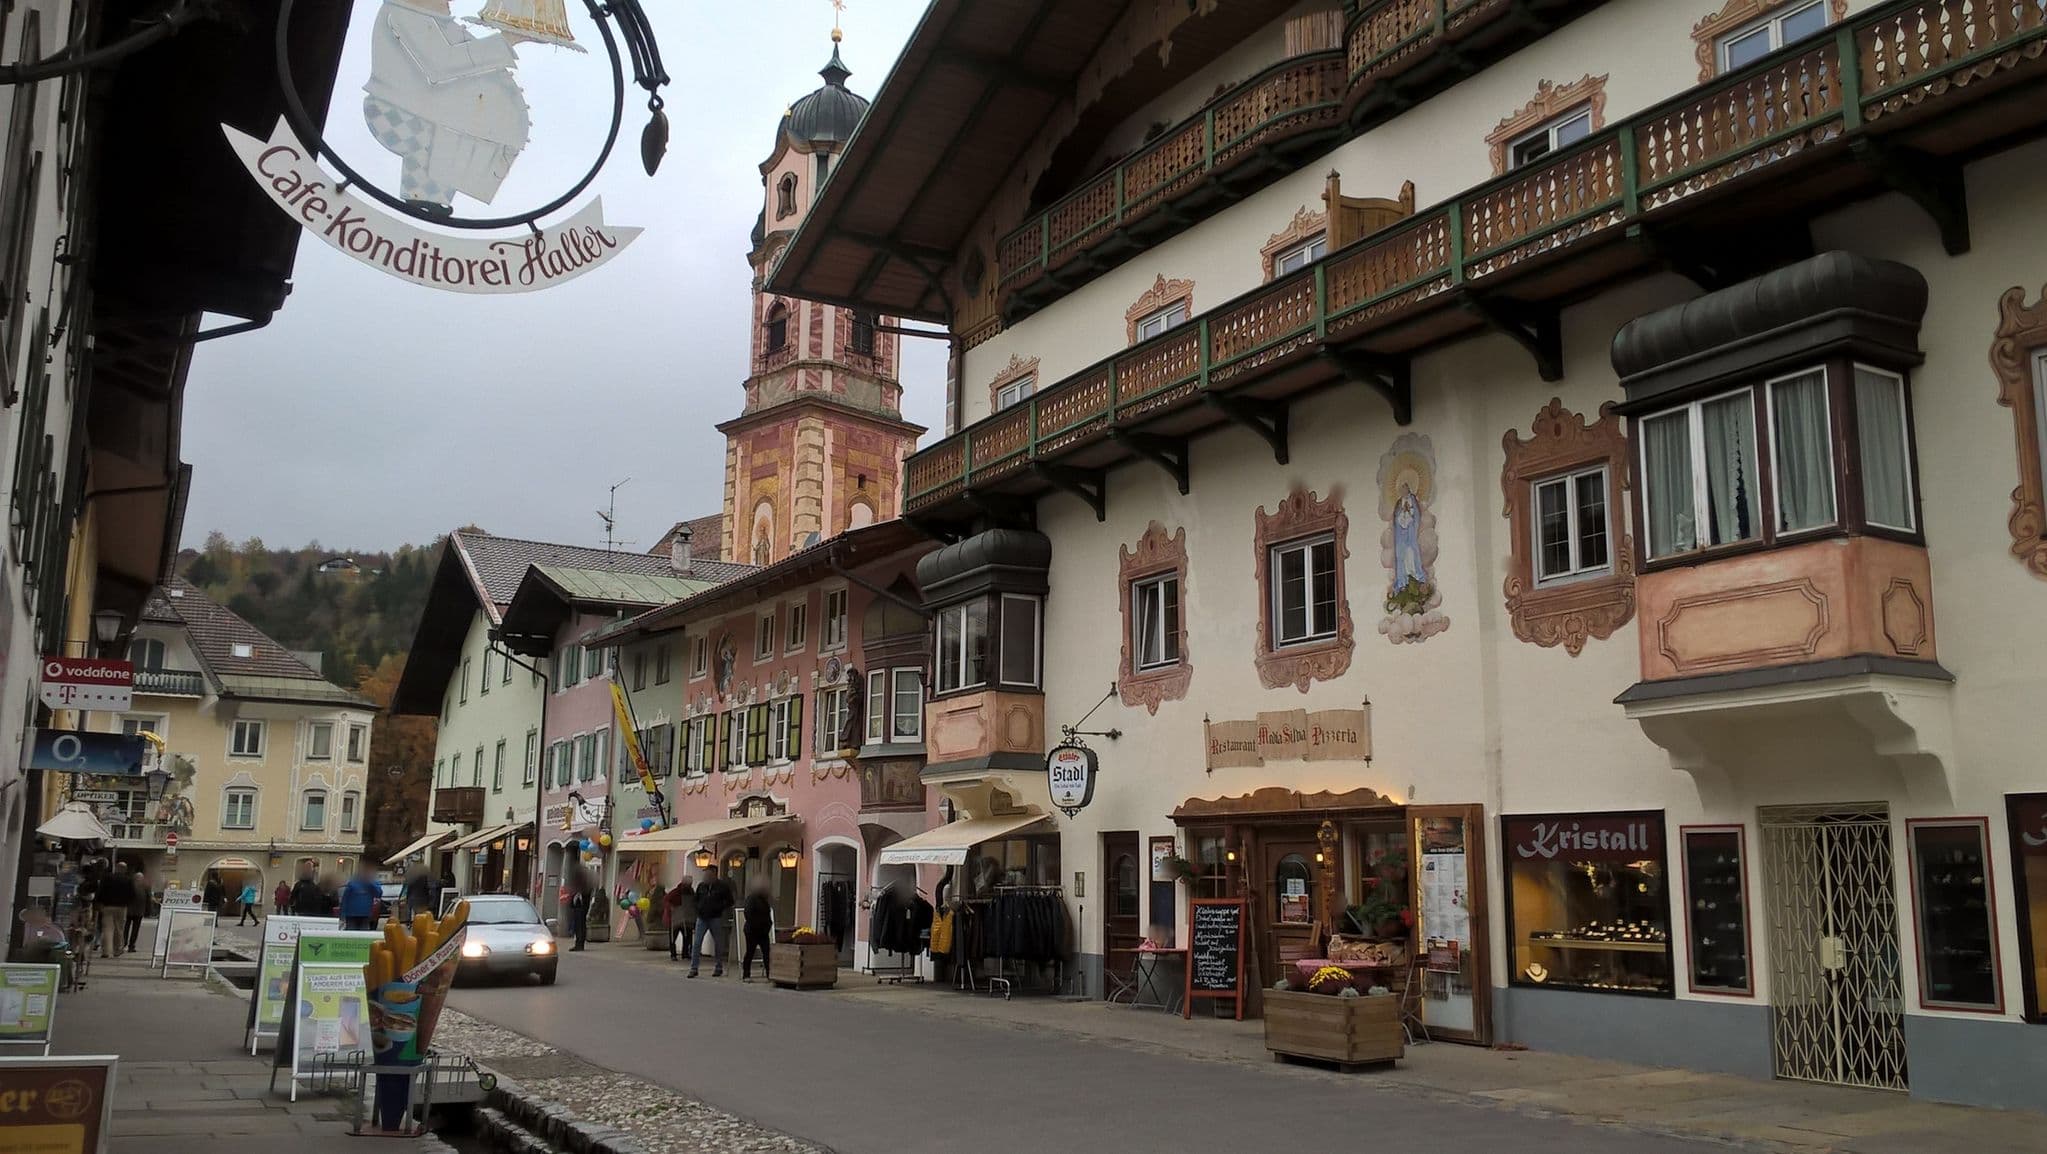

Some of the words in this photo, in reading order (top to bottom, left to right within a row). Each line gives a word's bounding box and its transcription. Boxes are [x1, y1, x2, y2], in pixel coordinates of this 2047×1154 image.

[490, 225, 617, 286] Haller
[66, 666, 130, 680] vodafone
[60, 685, 77, 705] T
[1210, 739, 1256, 756] Restaurant
[1312, 727, 1358, 746] Pizzeria
[1053, 765, 1084, 782] Stadl
[1516, 822, 1649, 858] Kristall
[435, 943, 454, 961] Pizza
